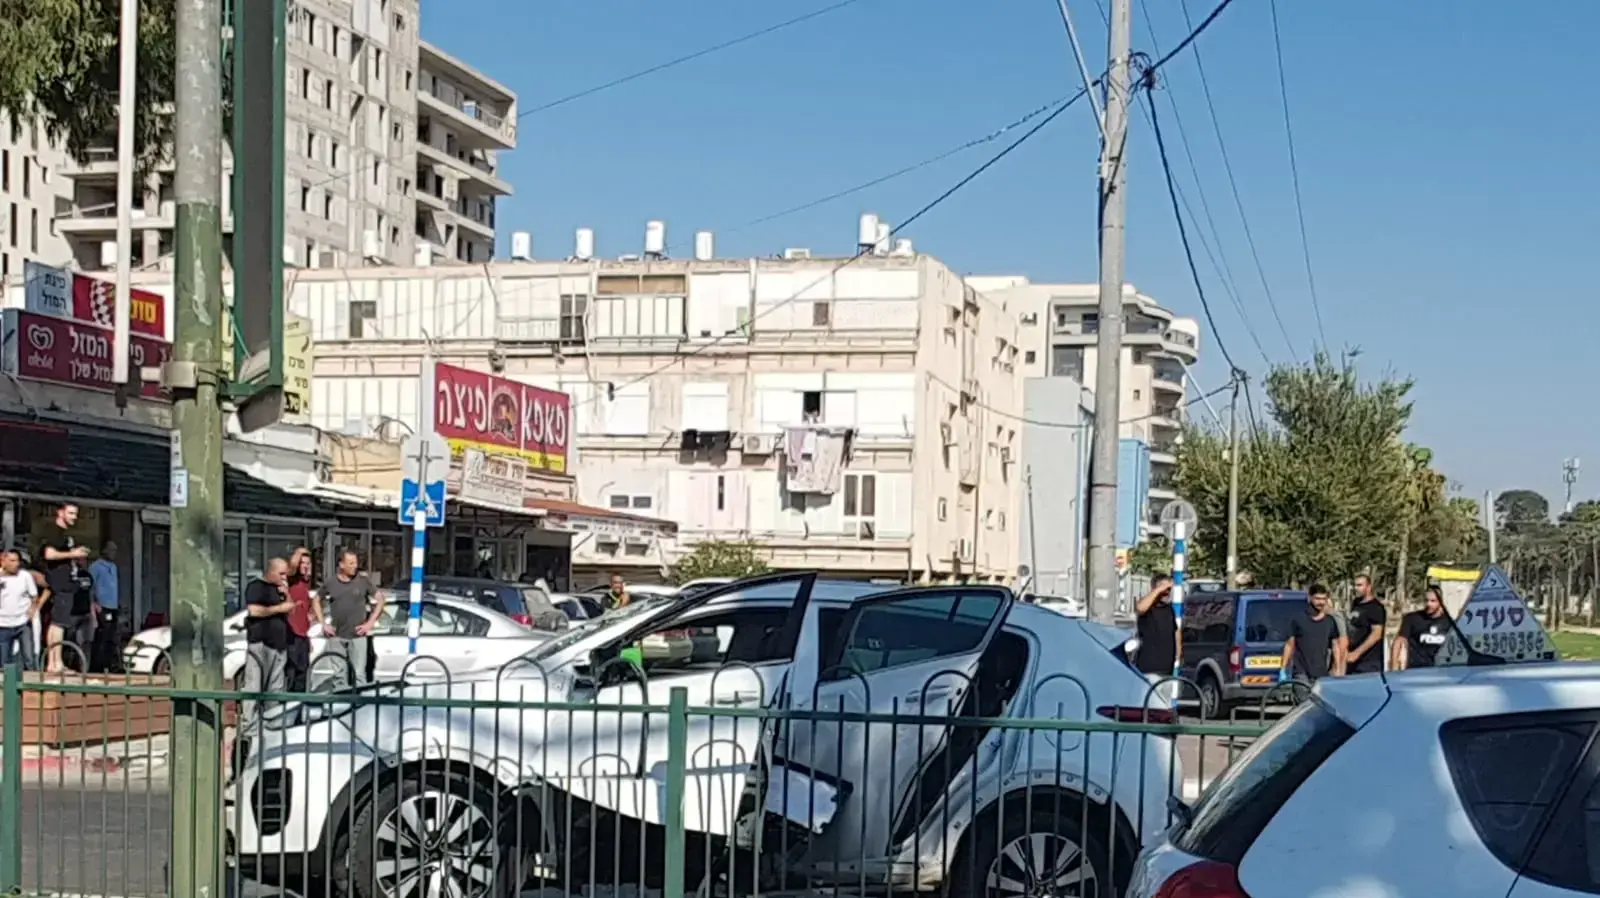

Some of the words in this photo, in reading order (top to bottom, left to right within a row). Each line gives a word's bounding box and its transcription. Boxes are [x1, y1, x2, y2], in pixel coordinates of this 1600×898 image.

[69, 325, 108, 359] המזל
[69, 357, 91, 380] שלך
[438, 379, 488, 433] פיצה
[523, 397, 566, 446] פאפא
[1463, 605, 1525, 630] סעדי
